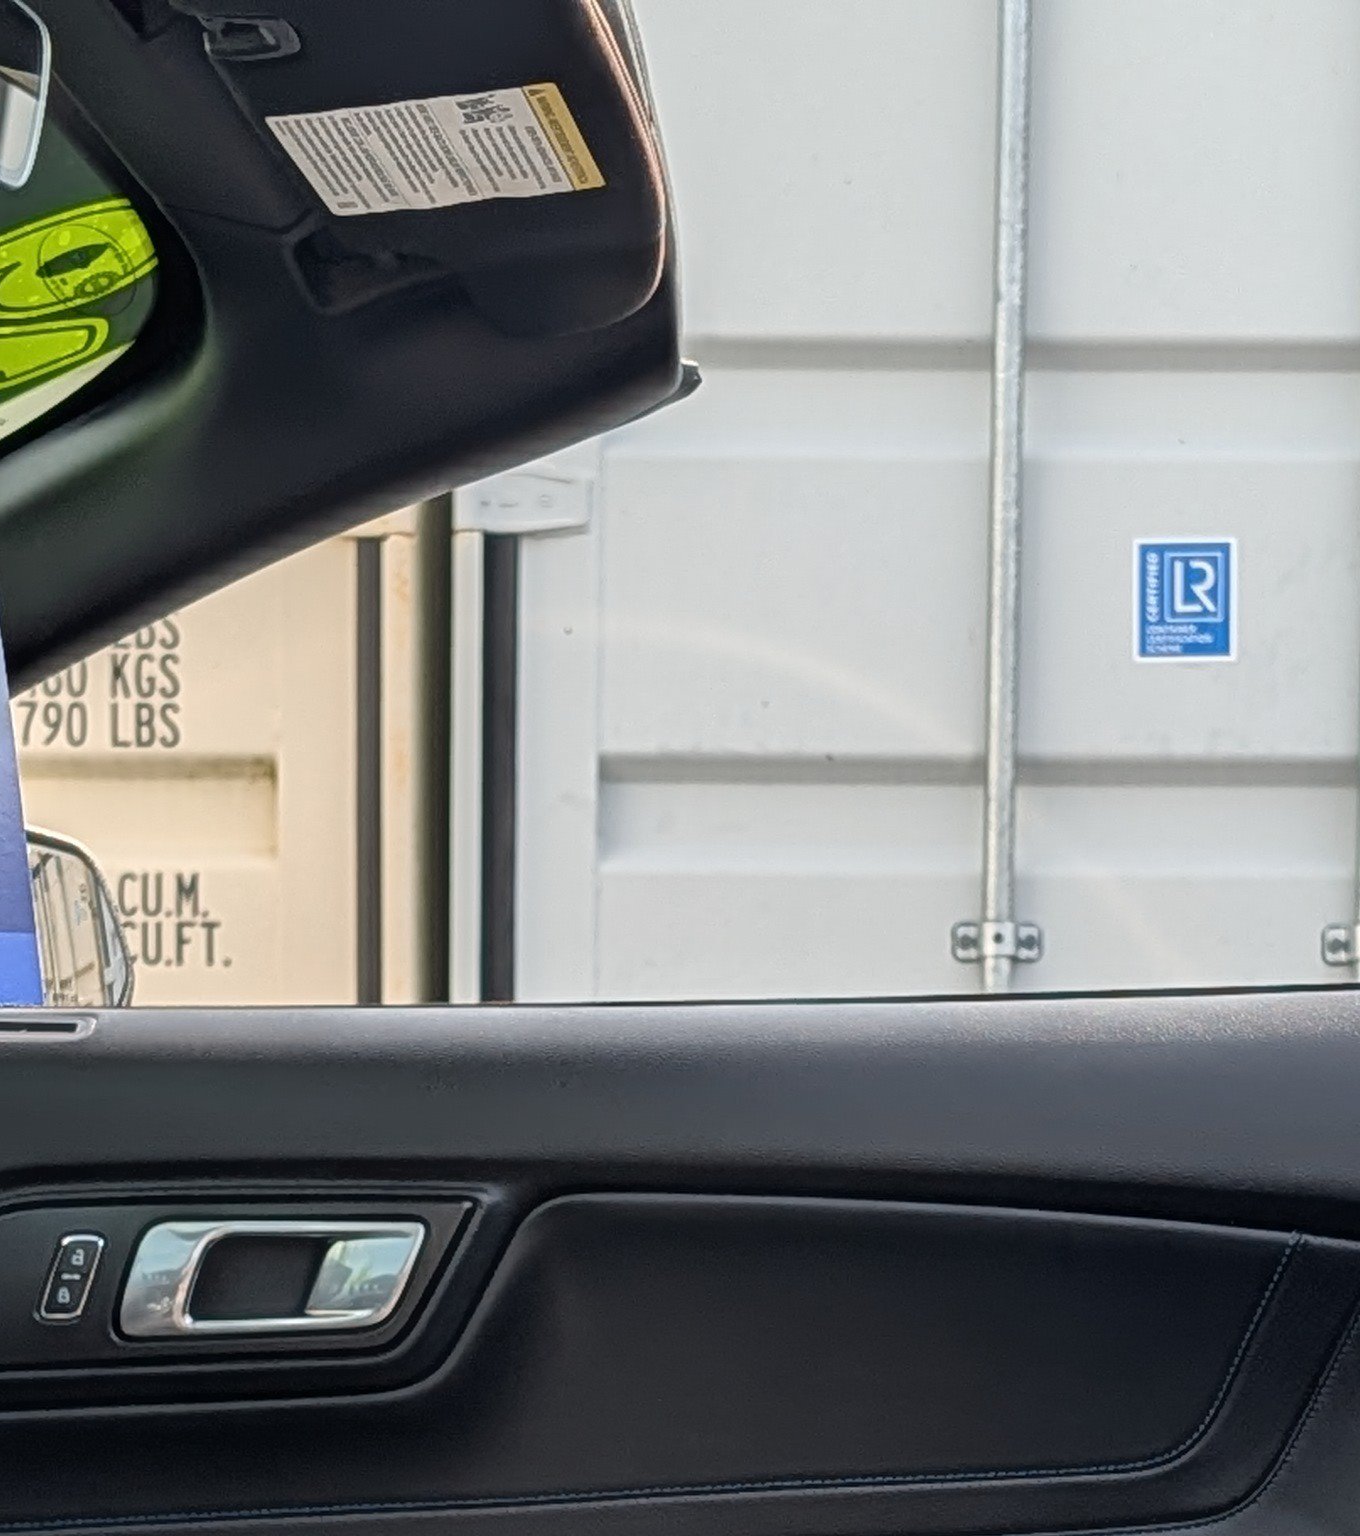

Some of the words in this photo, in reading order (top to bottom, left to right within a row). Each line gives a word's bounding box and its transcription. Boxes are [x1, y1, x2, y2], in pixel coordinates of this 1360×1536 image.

[1173, 560, 1217, 613] LR
[110, 653, 180, 699] KGS
[17, 701, 88, 748] 790
[110, 702, 180, 749] LBS
[118, 872, 209, 918] CU.M.
